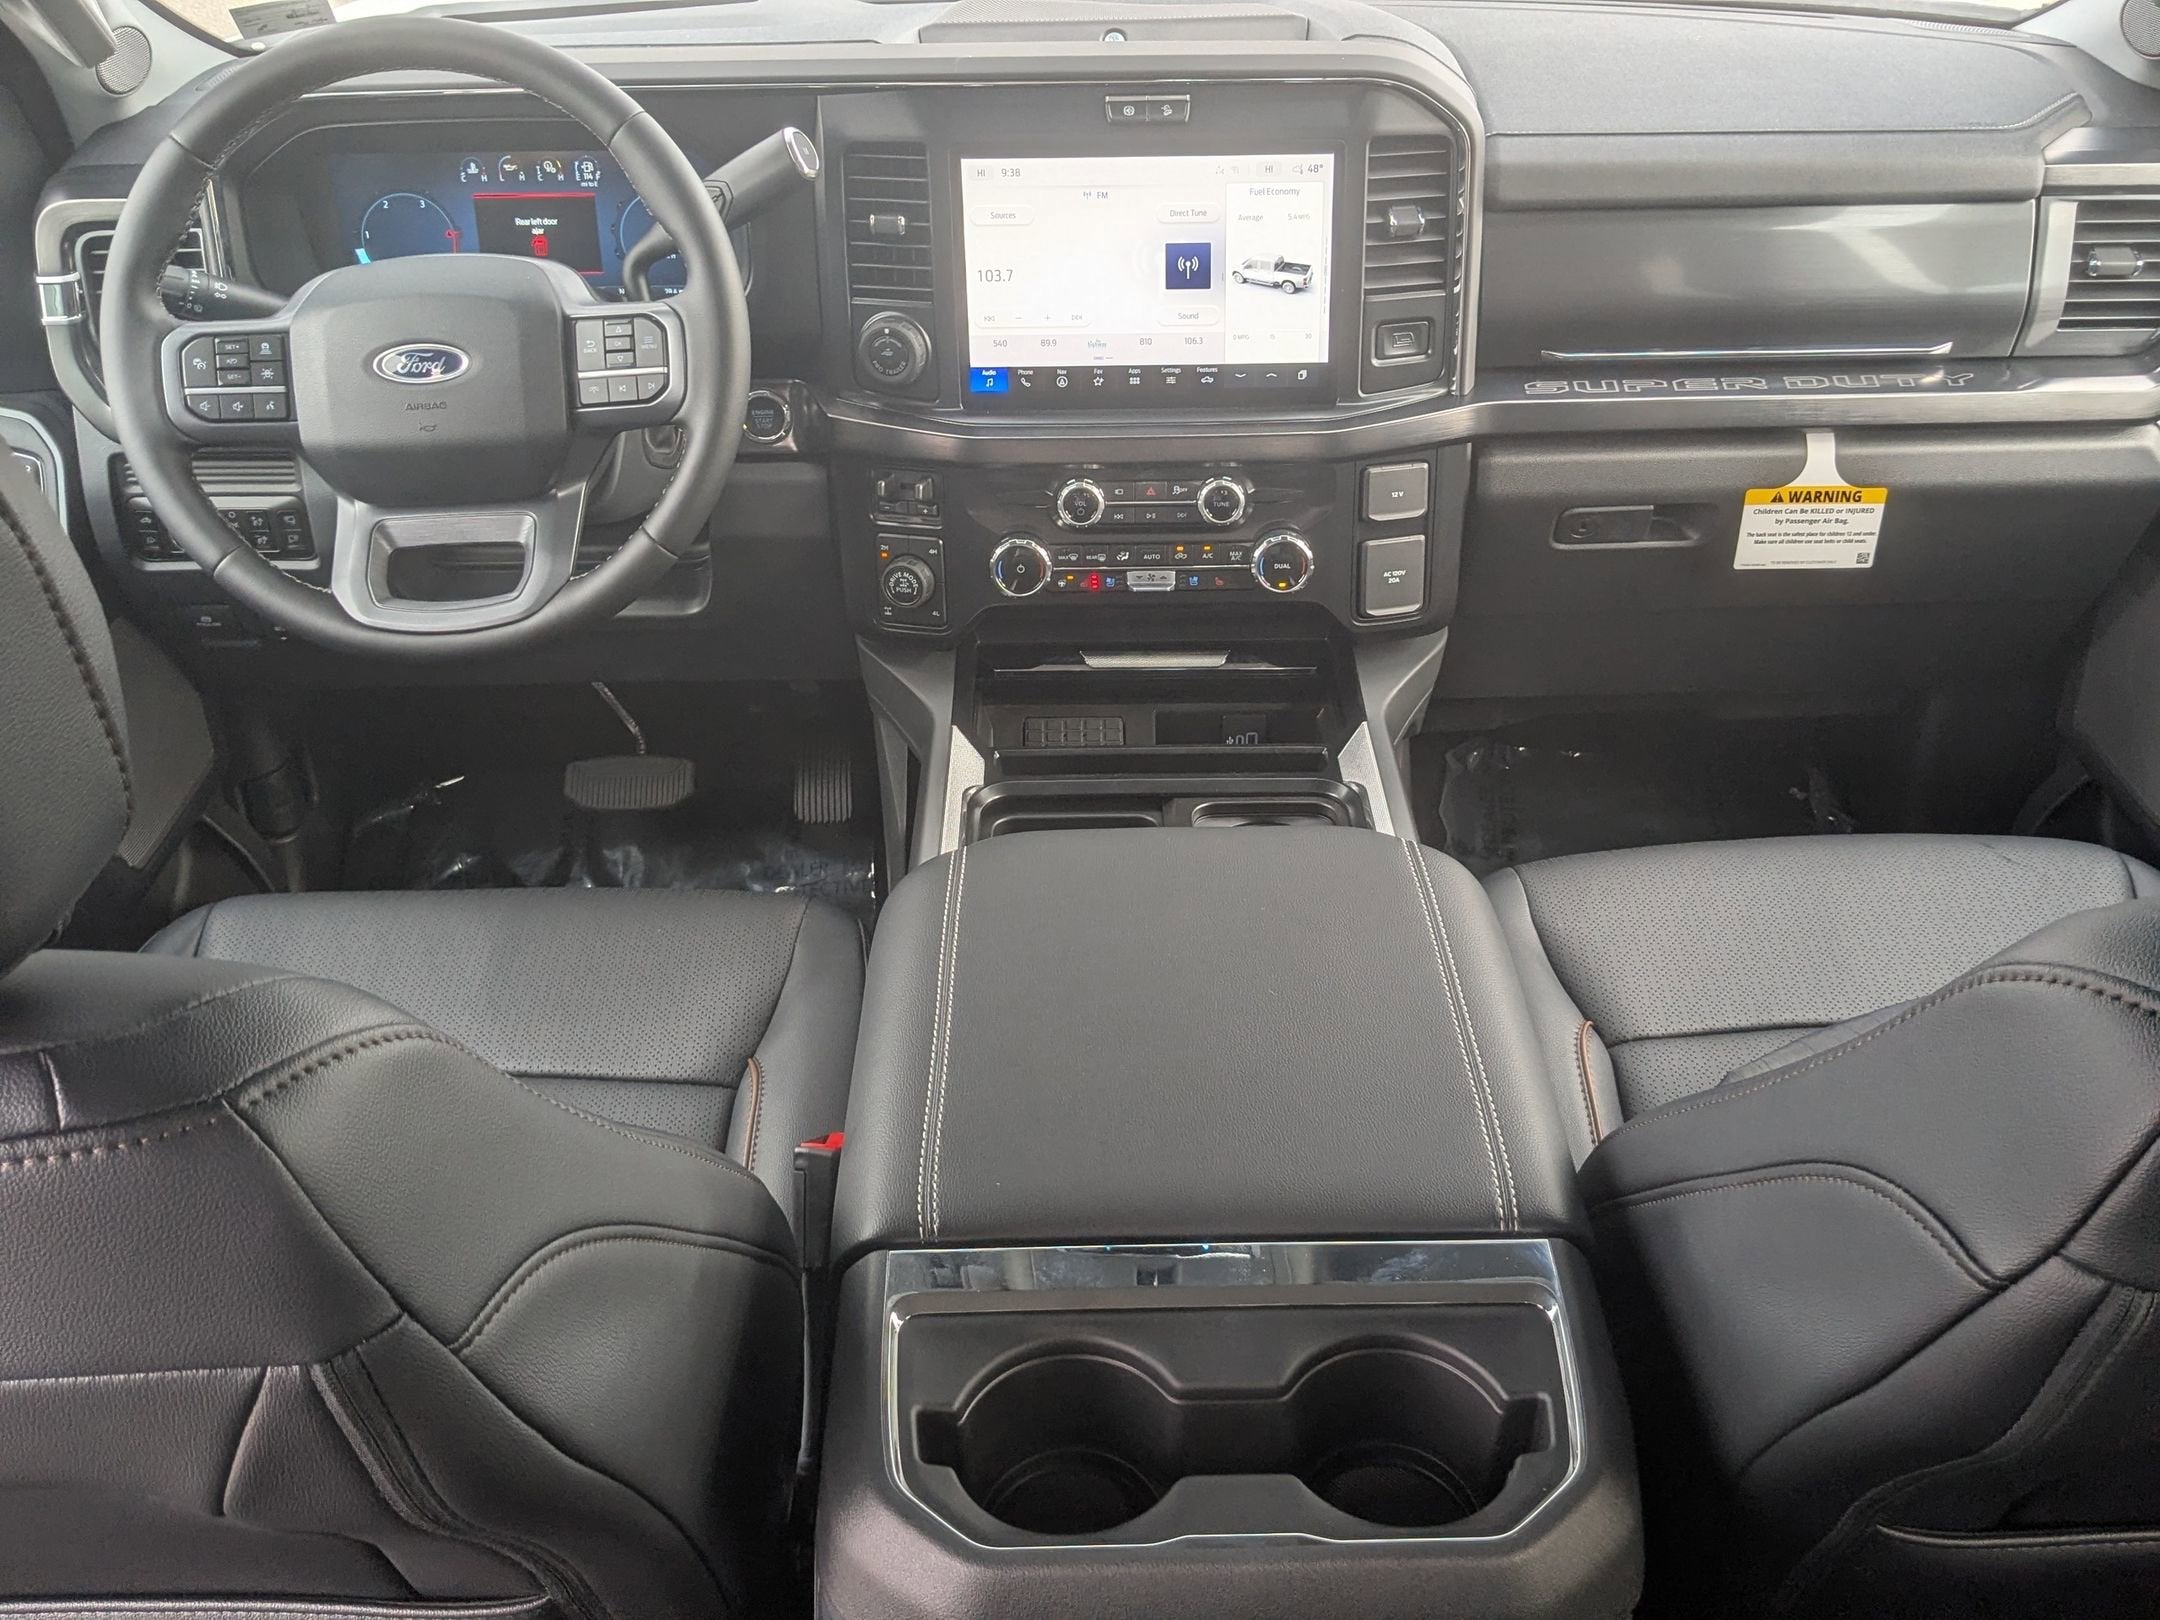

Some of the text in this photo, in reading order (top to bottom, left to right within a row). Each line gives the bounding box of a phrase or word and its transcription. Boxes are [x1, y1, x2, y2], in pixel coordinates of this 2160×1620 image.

[976, 168, 986, 177] HI
[1001, 168, 1021, 177] 9:38
[1096, 191, 1109, 199] FM
[1249, 187, 1300, 196] Fuel Economy
[383, 201, 389, 209] 2
[419, 200, 426, 209] 3
[990, 211, 1016, 220] Sources
[1169, 209, 1207, 217] Direct Tune
[1237, 213, 1264, 223] Average
[977, 269, 1014, 282] 103.7
[1178, 312, 1199, 320] Sound
[993, 339, 1008, 348] 540
[1040, 339, 1057, 347] 89.9
[1139, 338, 1153, 346] 810
[1184, 337, 1203, 345] 106.3
[396, 352, 446, 378] Ford
[1128, 367, 1141, 375] Apps
[1160, 367, 1182, 375] Settings
[1524, 373, 1974, 395] SUPER DUTY
[405, 401, 447, 411] AIRBAG
[1789, 490, 1863, 503] WARNING
[1845, 507, 1875, 515] INJURED
[1202, 552, 1214, 560] A/C
[1392, 569, 1406, 577] 120V
